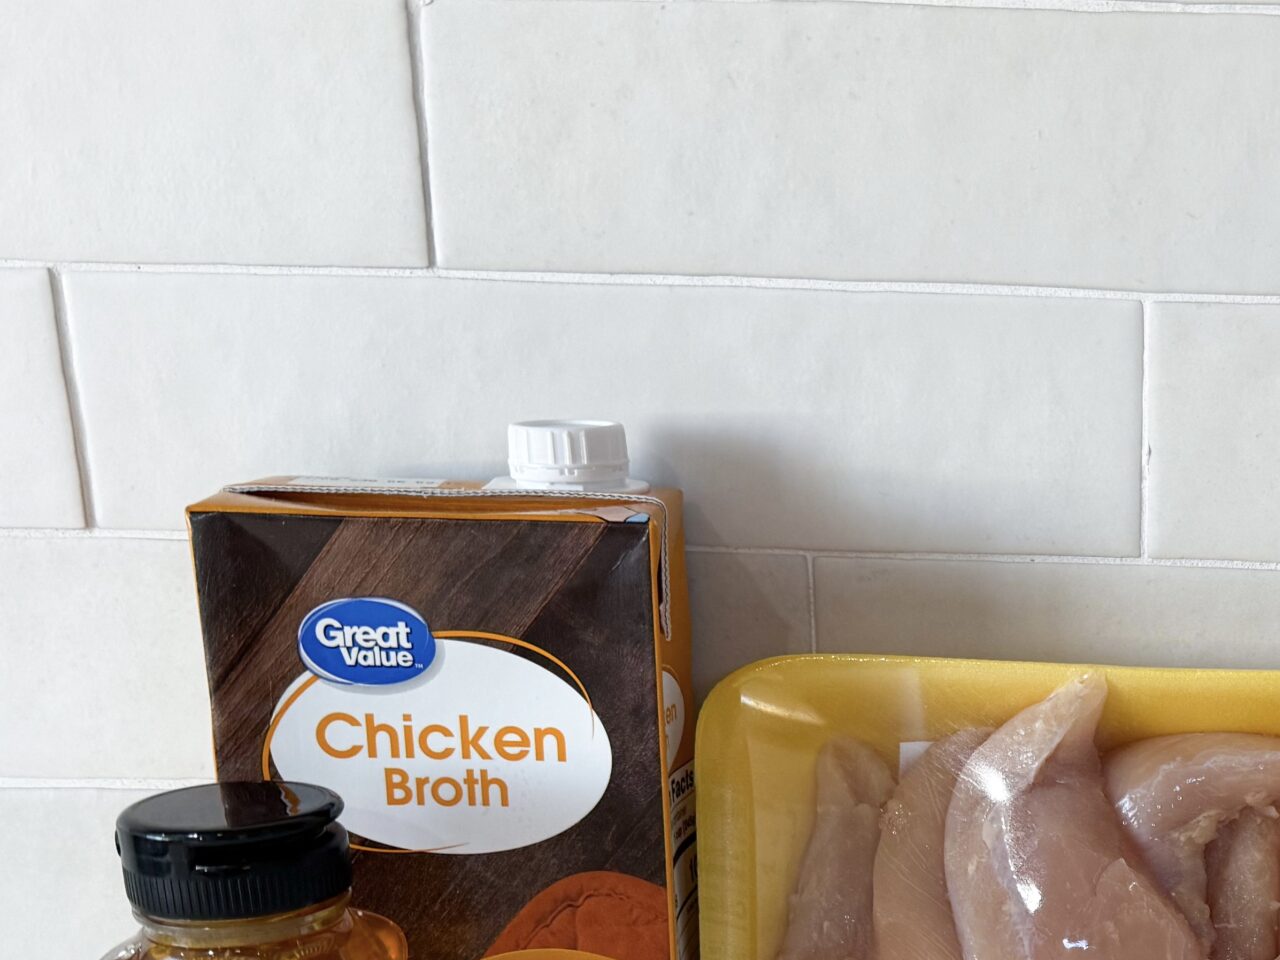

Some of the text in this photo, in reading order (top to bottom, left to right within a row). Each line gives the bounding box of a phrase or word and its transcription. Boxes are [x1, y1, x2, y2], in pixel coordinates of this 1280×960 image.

[315, 617, 412, 649] Great
[340, 648, 413, 667] Value
[315, 712, 567, 762] Chicken
[384, 768, 509, 807] Broth
